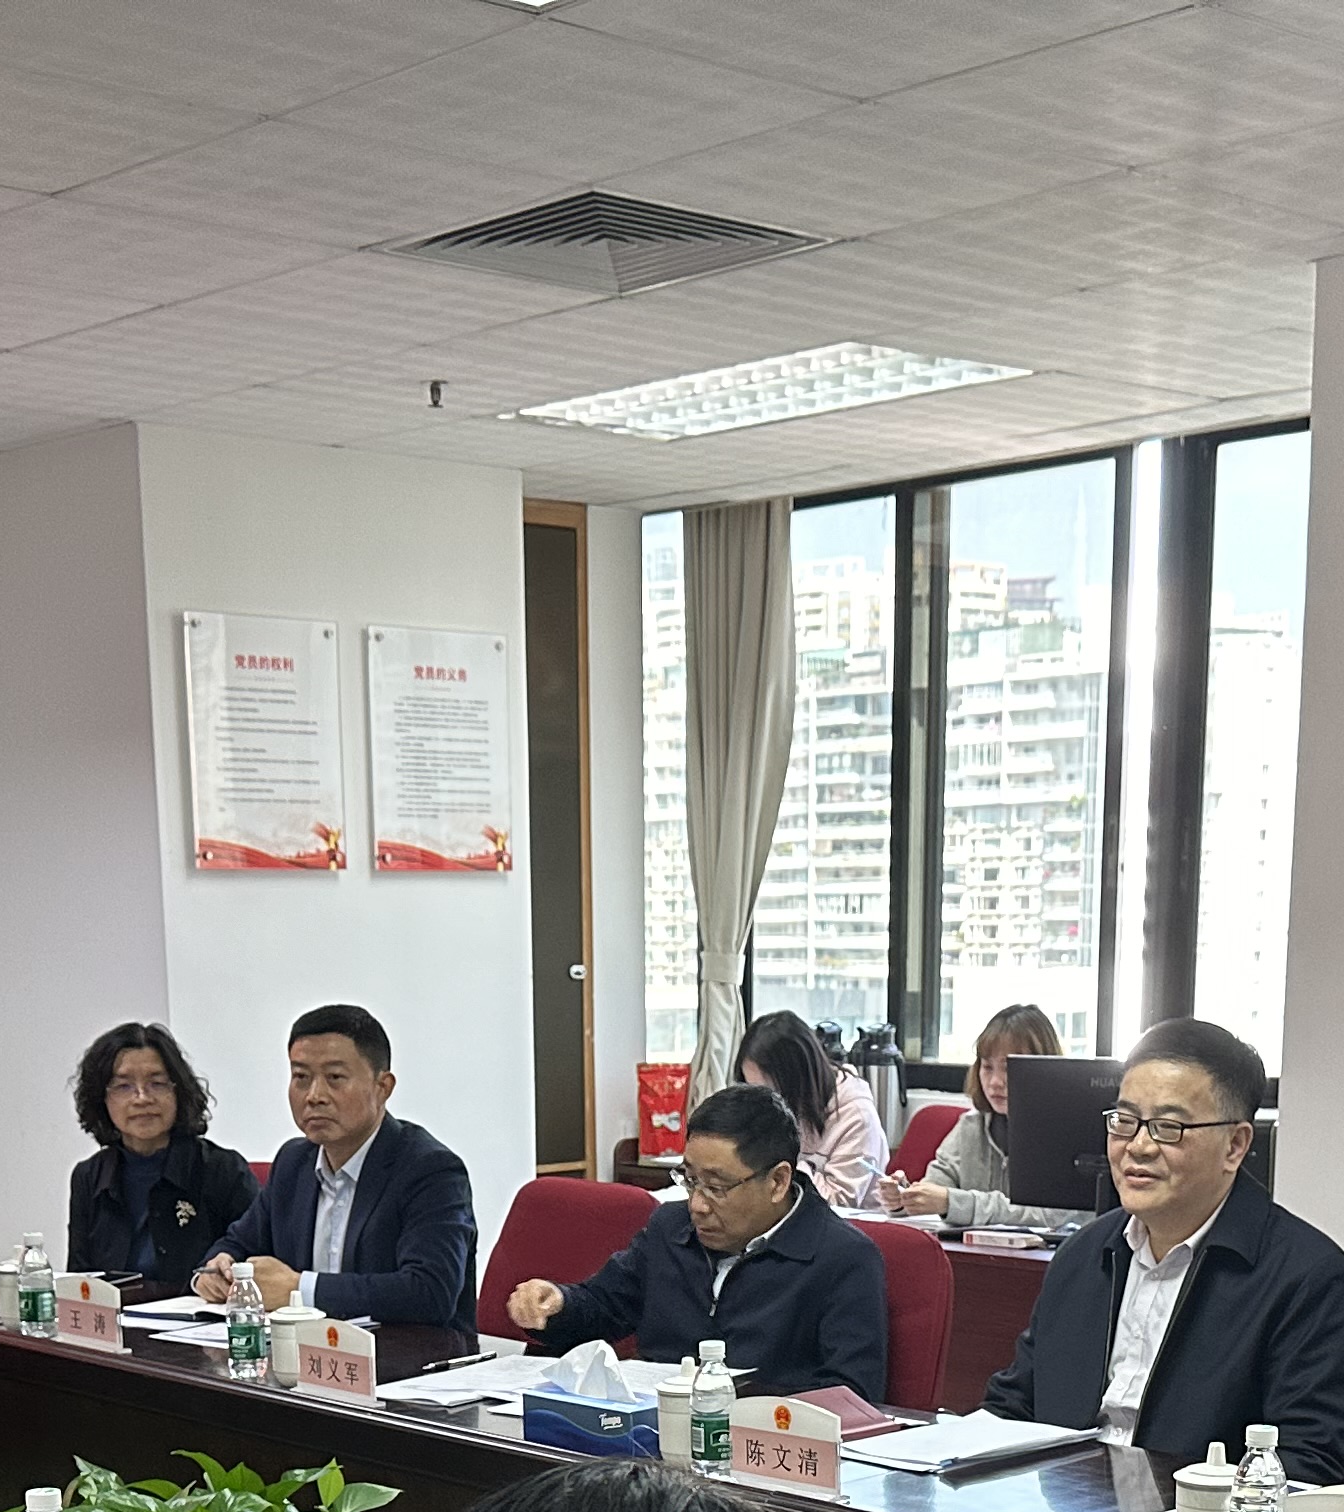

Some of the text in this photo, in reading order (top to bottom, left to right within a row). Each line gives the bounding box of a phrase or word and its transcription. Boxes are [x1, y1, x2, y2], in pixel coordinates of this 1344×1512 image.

[308, 1353, 360, 1386] 刘义军
[744, 1438, 819, 1477] 陈文清
